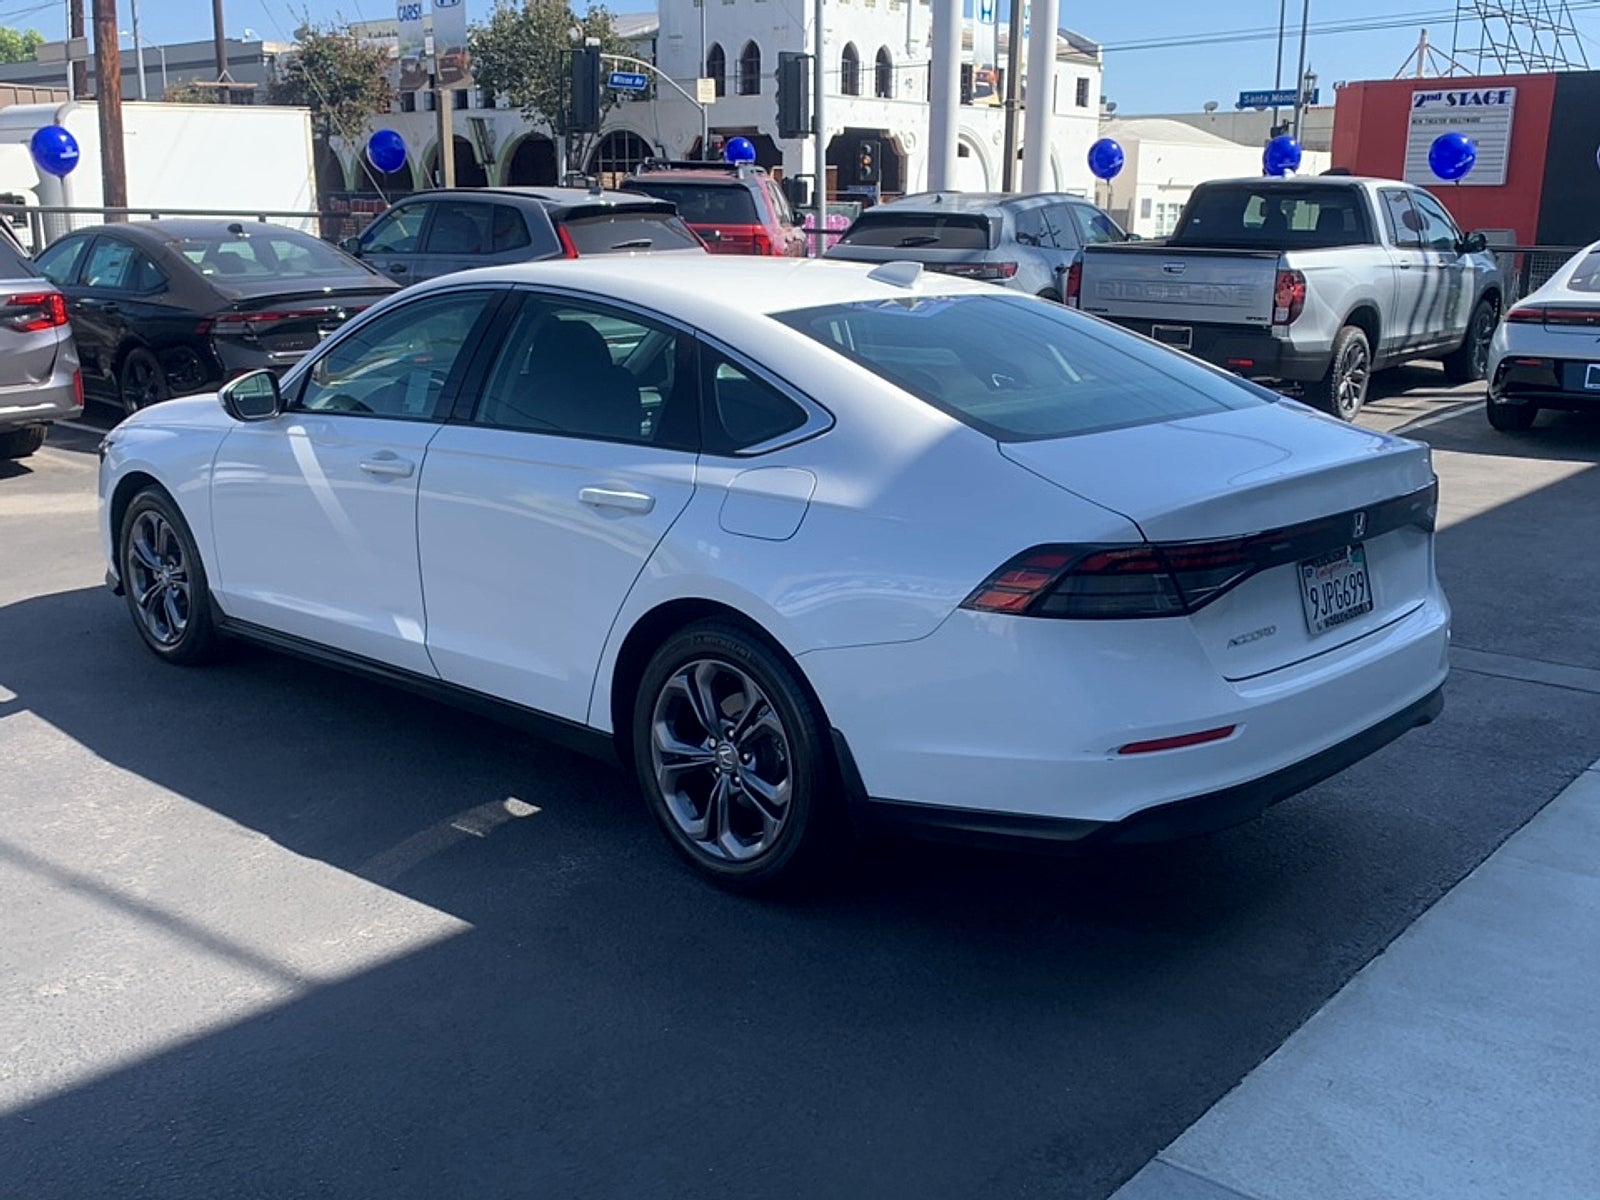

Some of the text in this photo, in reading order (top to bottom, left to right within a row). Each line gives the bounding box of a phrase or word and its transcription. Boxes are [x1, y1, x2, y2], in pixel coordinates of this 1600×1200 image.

[398, 3, 421, 21] CARS!
[1243, 92, 1298, 104] Santa Monic
[1413, 89, 1511, 109] 2nd STAGE
[1095, 280, 1257, 301] RIDGELINE
[1309, 571, 1365, 620] 9JPG699
[1227, 625, 1276, 649] ACCORD
